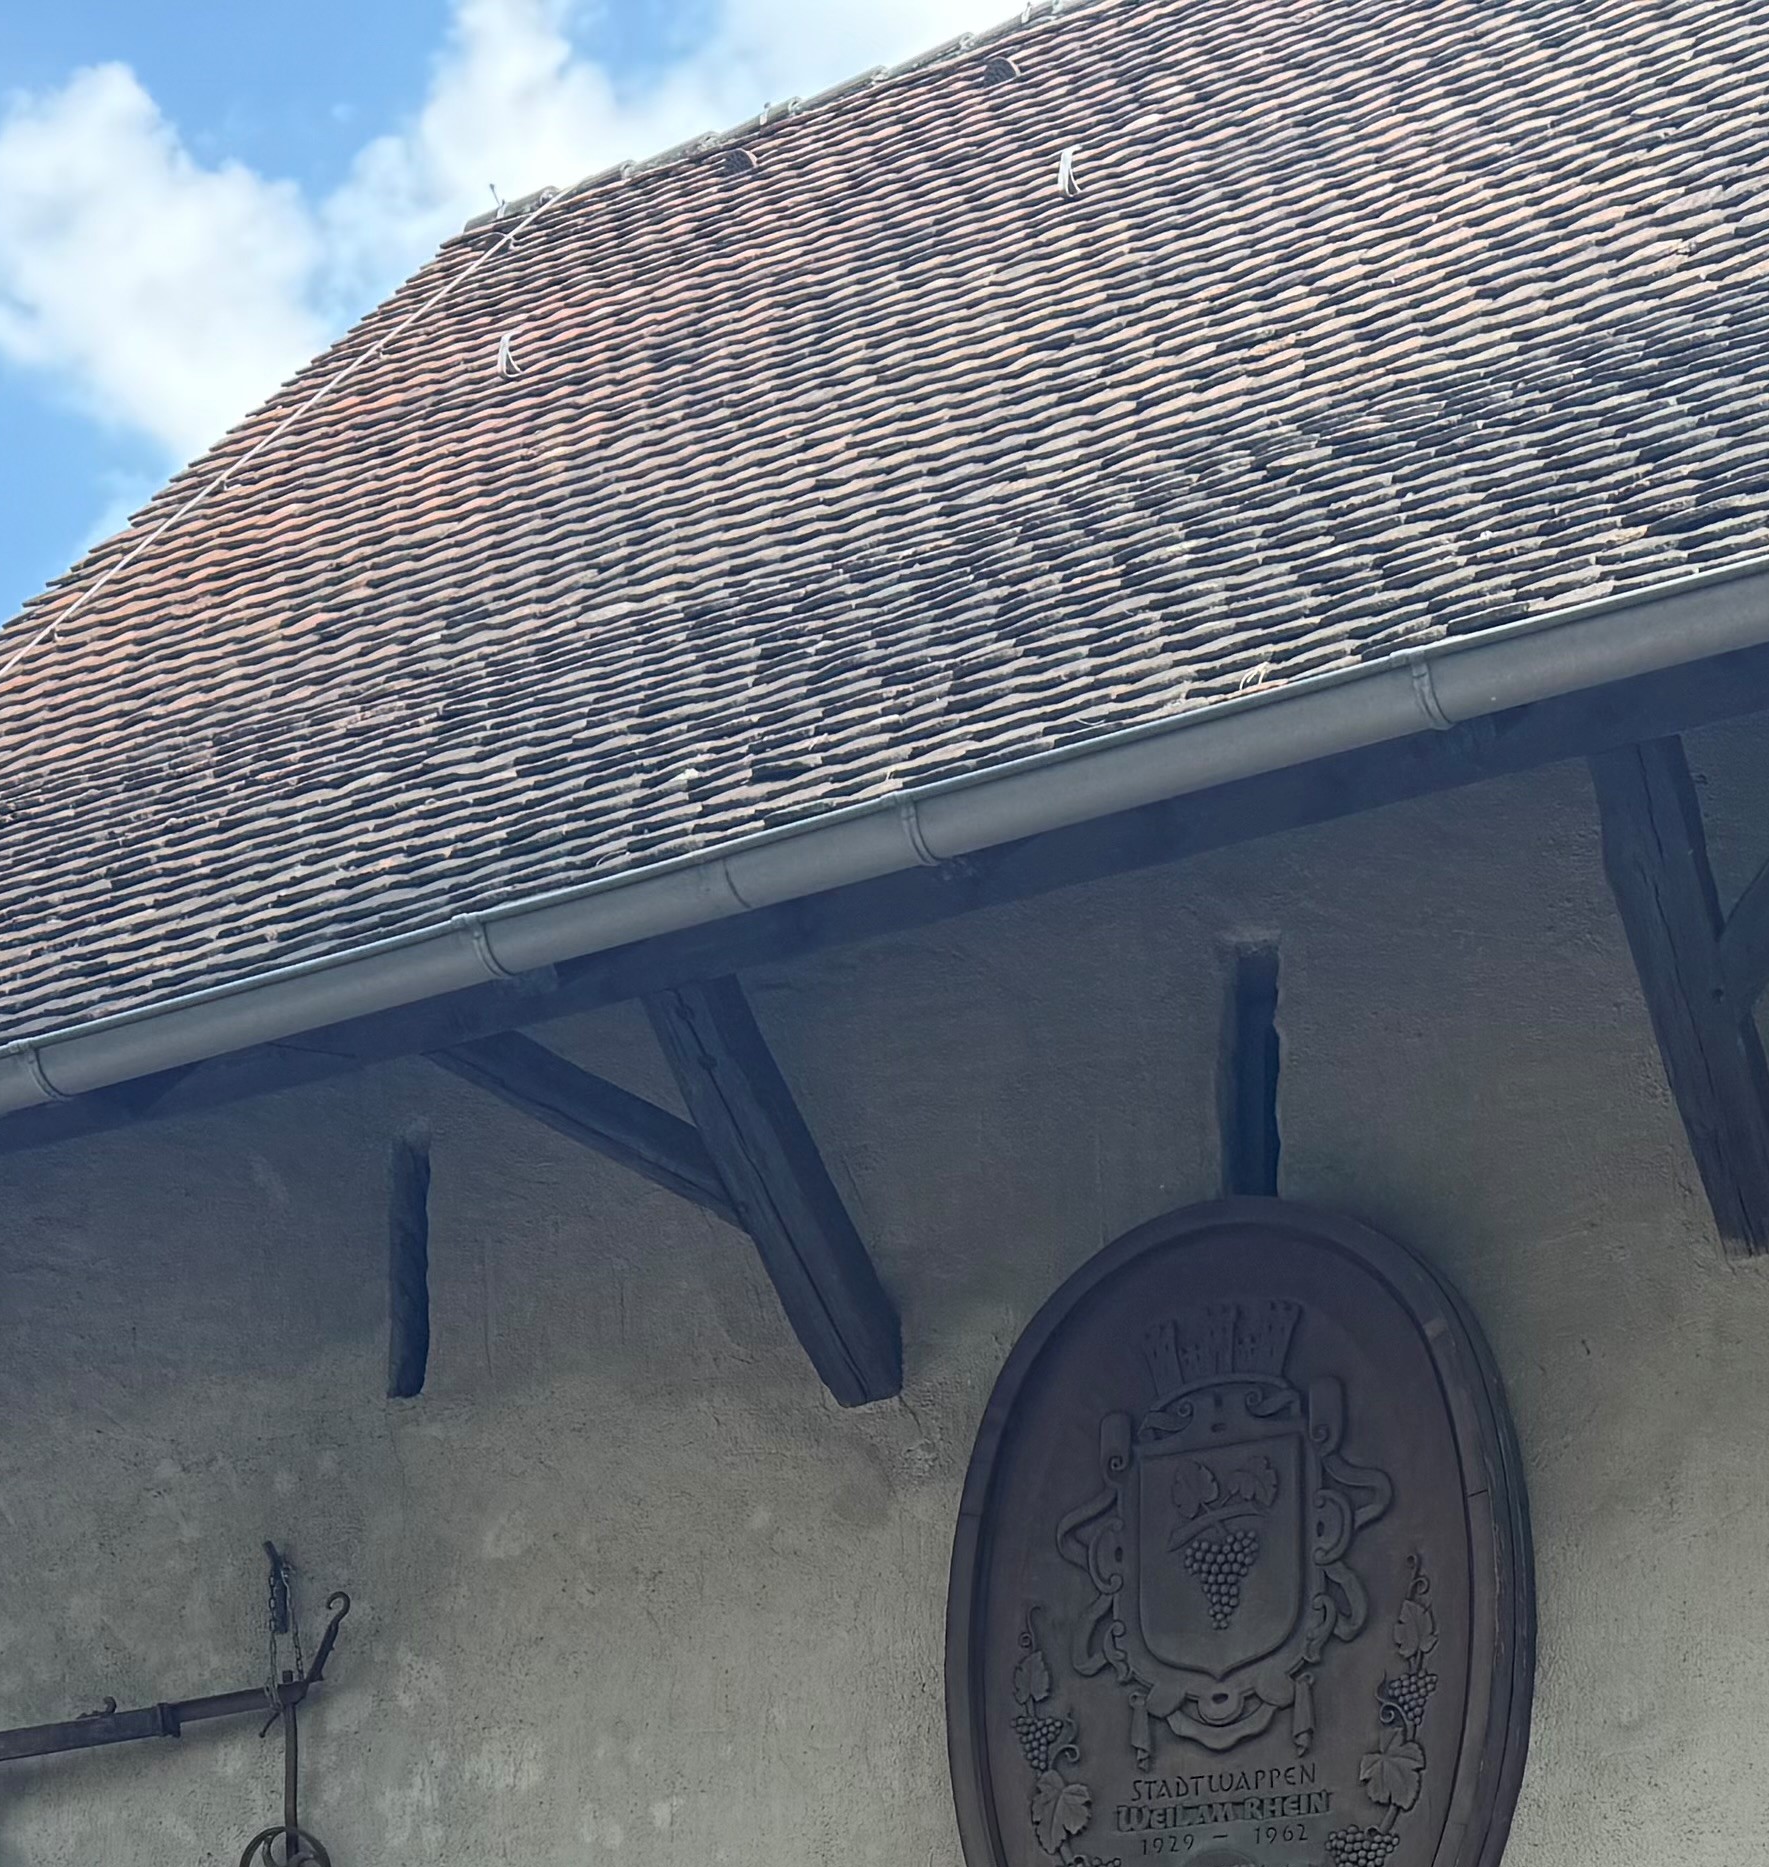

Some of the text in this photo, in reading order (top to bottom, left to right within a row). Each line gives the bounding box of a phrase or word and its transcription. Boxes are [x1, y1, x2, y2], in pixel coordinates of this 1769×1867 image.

[1131, 1762, 1317, 1802] STADTWAPPEN
[1114, 1789, 1330, 1833] WEIL AM RHEIN
[1141, 1834, 1195, 1856] 1929
[1254, 1823, 1309, 1845] 1962
